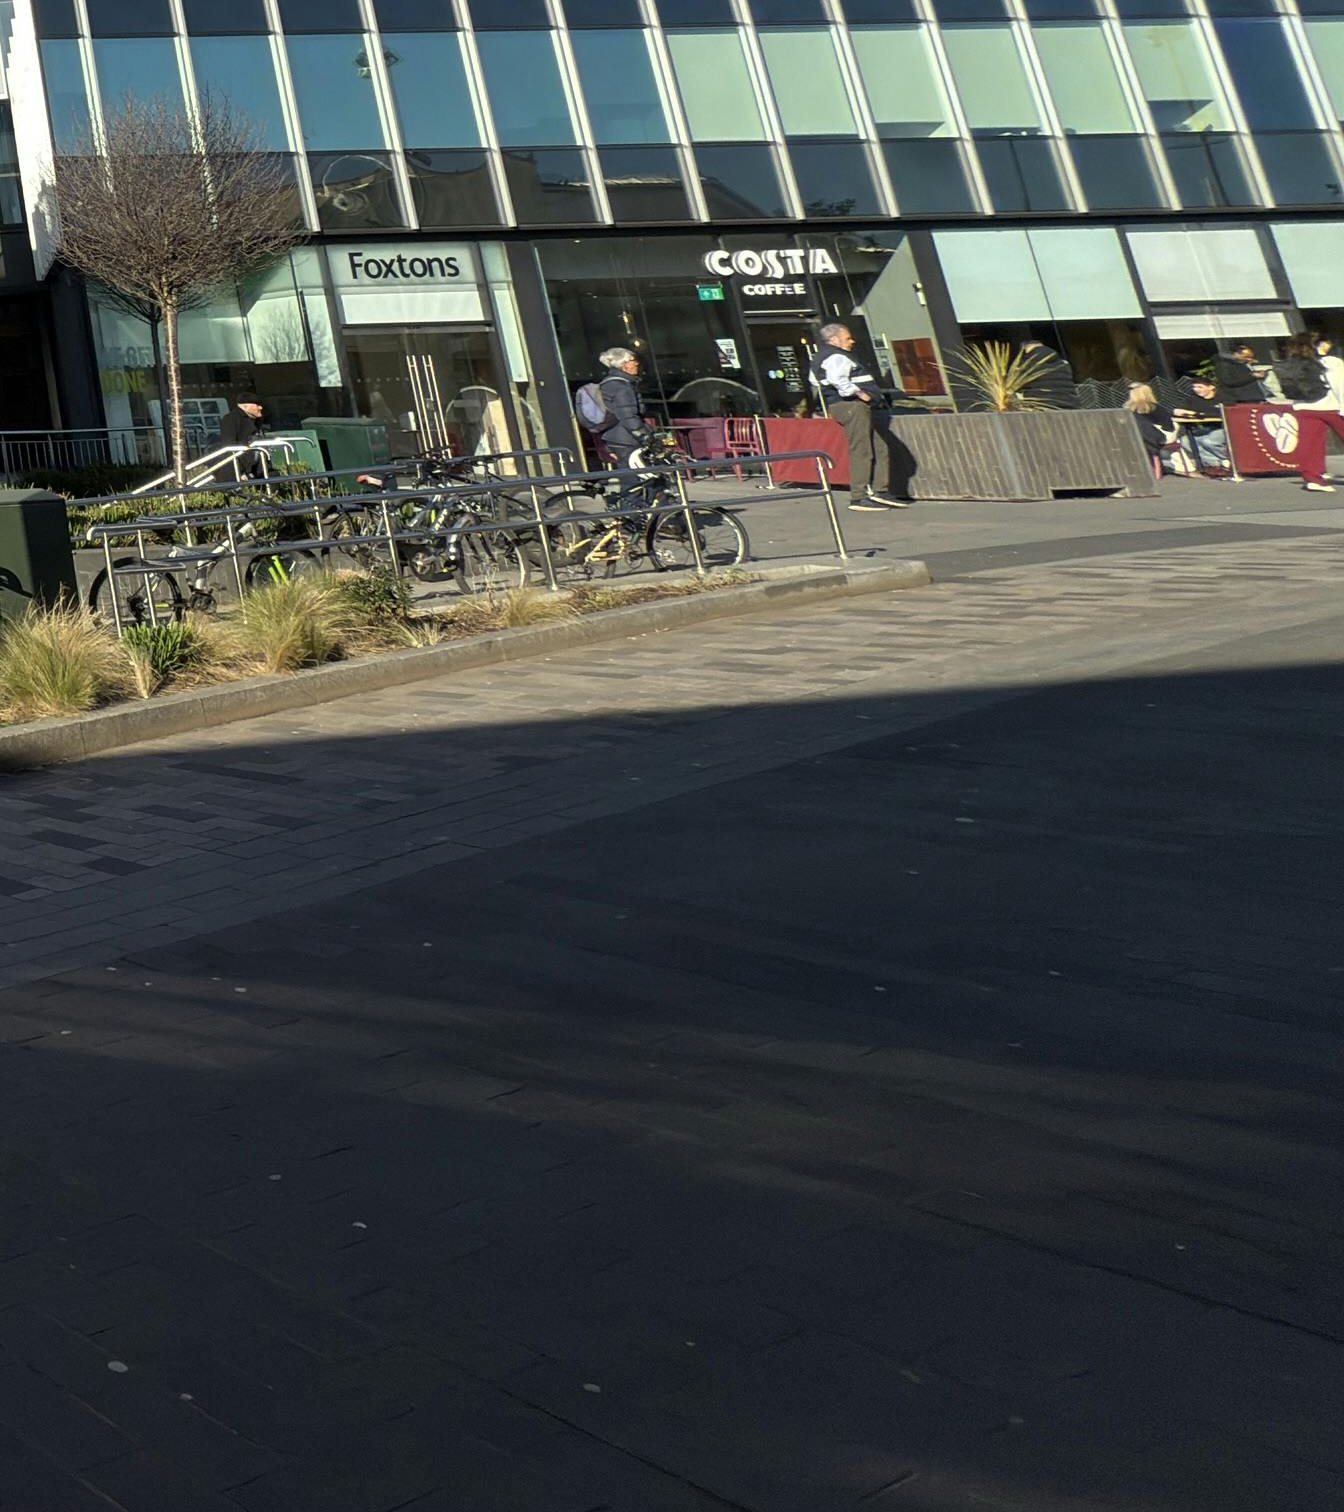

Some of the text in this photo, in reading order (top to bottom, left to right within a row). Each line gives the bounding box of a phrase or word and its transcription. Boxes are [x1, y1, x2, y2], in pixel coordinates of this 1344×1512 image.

[348, 251, 460, 279] Foxtons
[703, 248, 839, 279] COSTA
[741, 283, 806, 296] COFFEE
